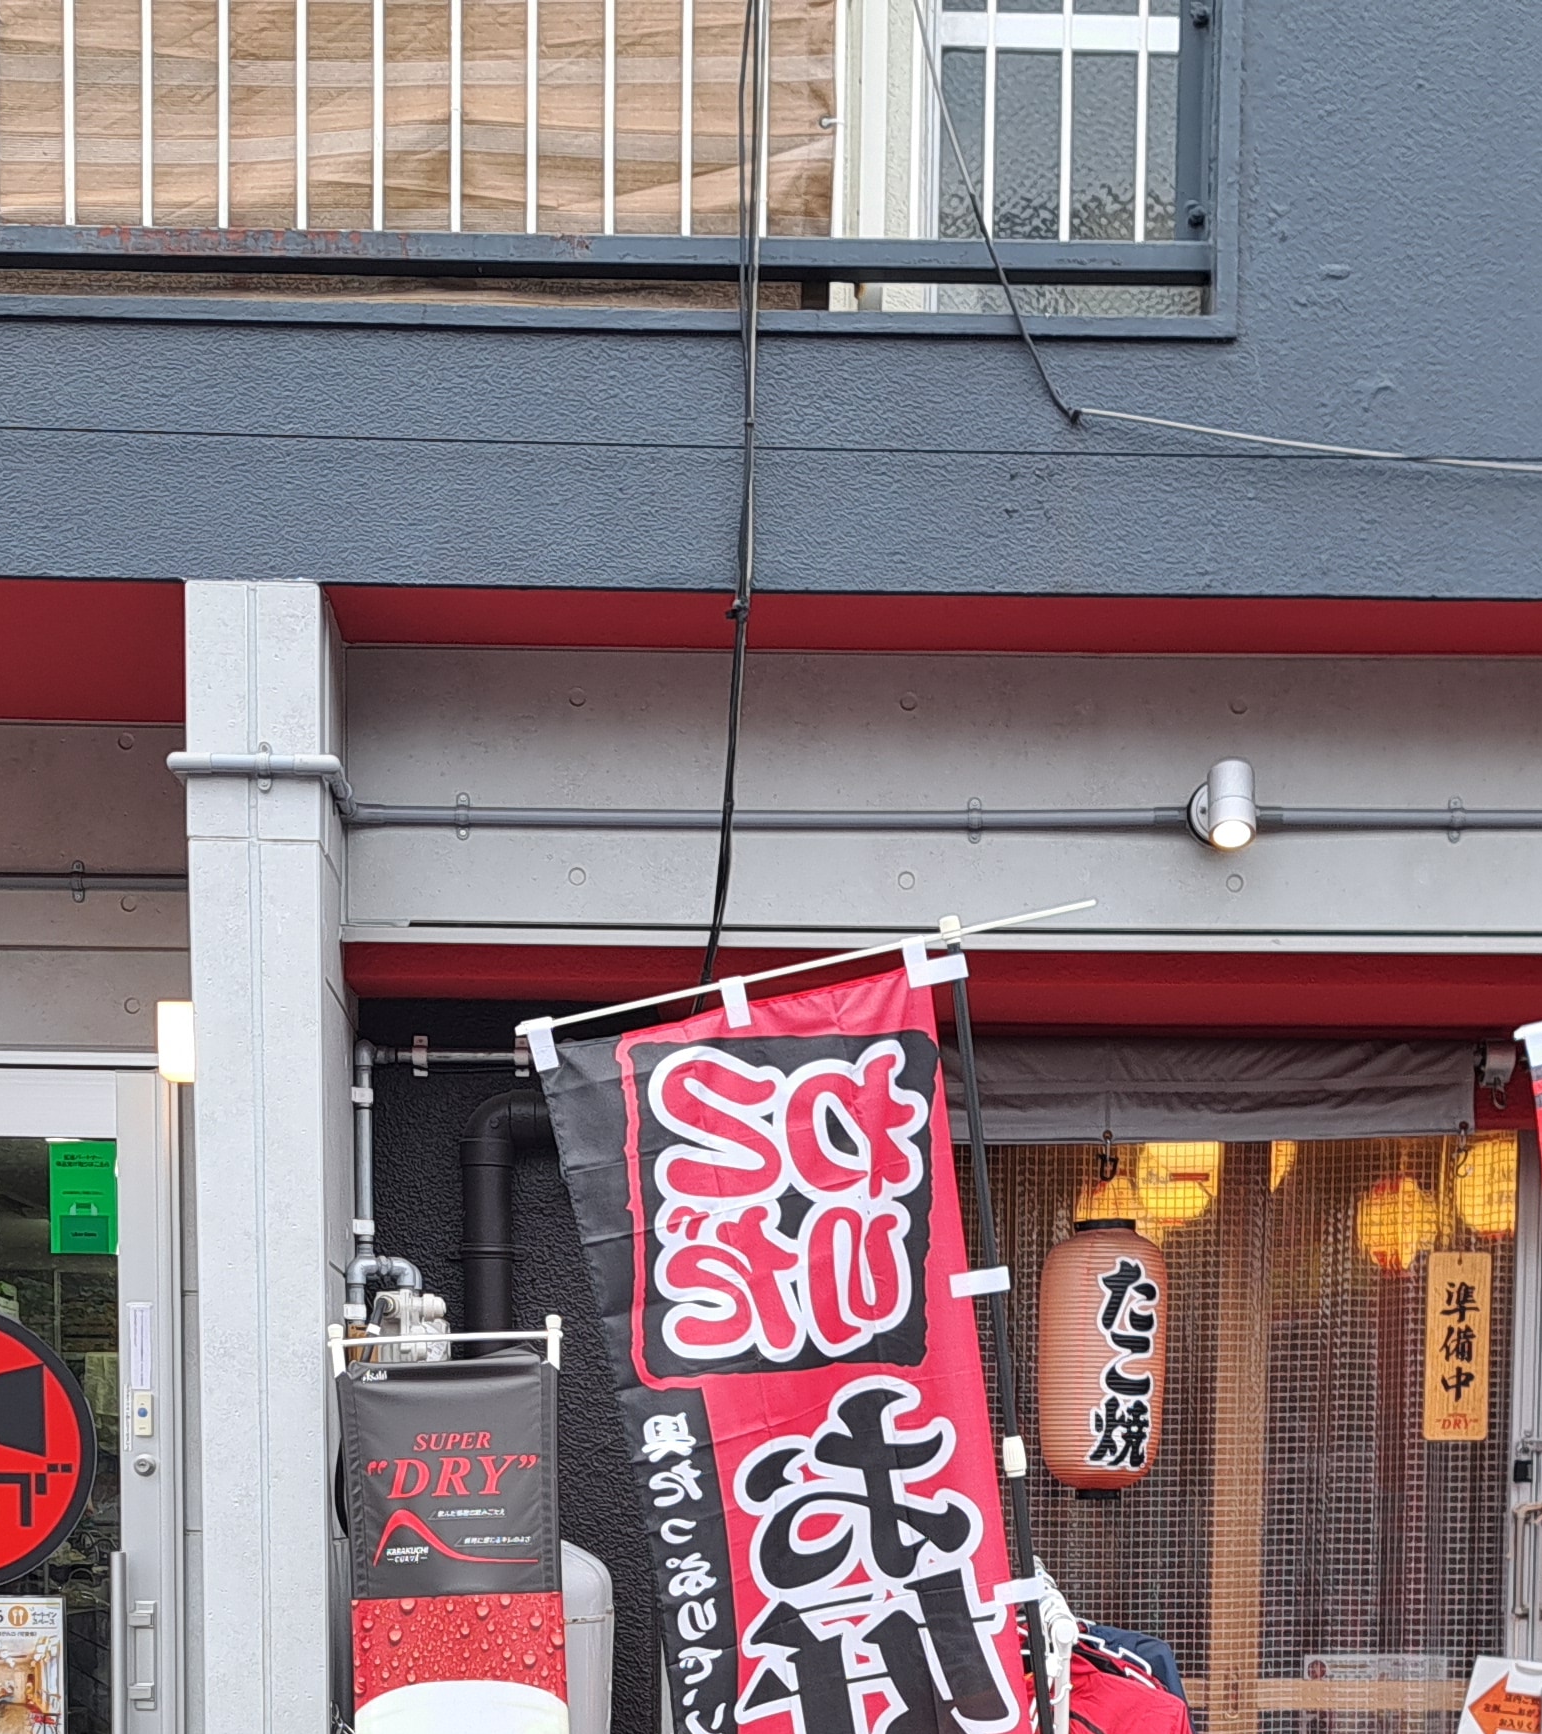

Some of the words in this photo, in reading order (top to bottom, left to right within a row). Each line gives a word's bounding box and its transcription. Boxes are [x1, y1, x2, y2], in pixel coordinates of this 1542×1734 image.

[1090, 1256, 1159, 1470] たこ焼
[1440, 1282, 1480, 1401] 準備中
[413, 1432, 492, 1452] SUPER
